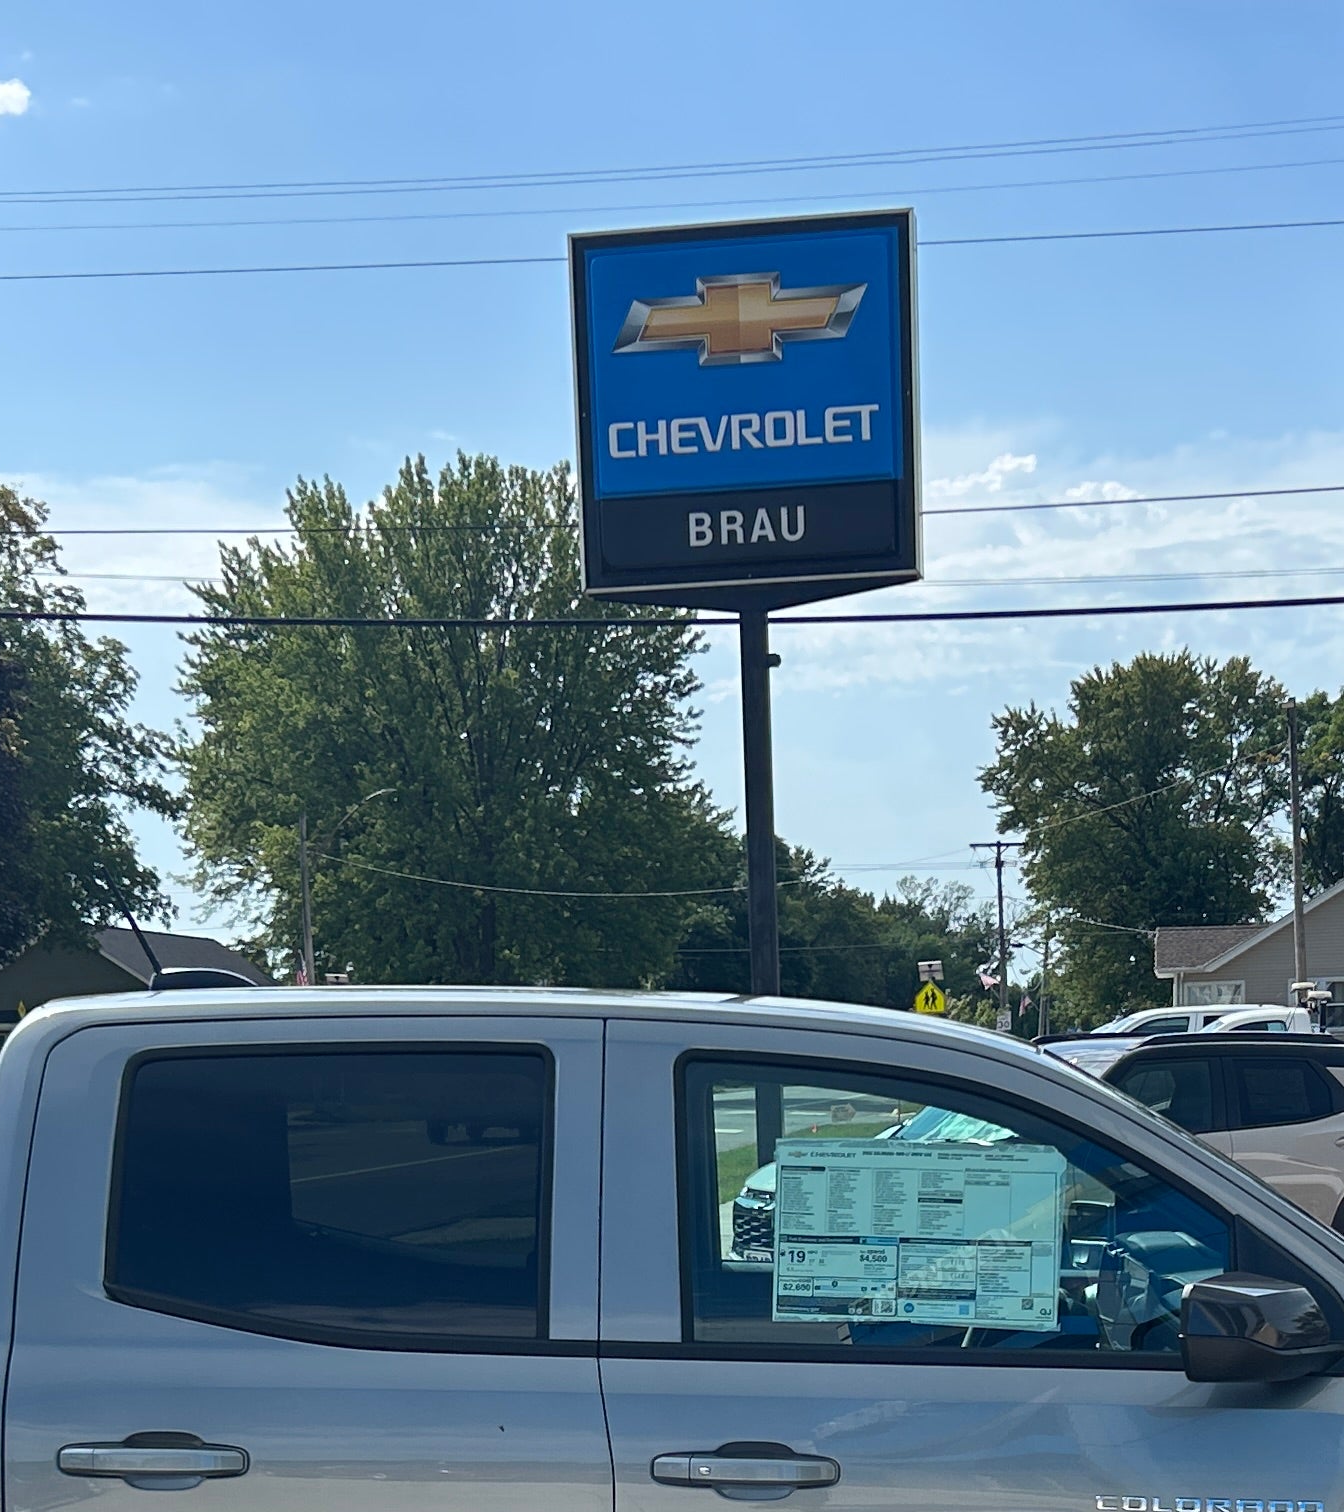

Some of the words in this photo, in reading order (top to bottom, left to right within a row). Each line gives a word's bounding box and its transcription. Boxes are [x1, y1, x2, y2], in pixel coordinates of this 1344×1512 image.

[608, 404, 879, 458] CHEVROLET
[688, 505, 806, 547] BRAU
[788, 1250, 806, 1263] 19
